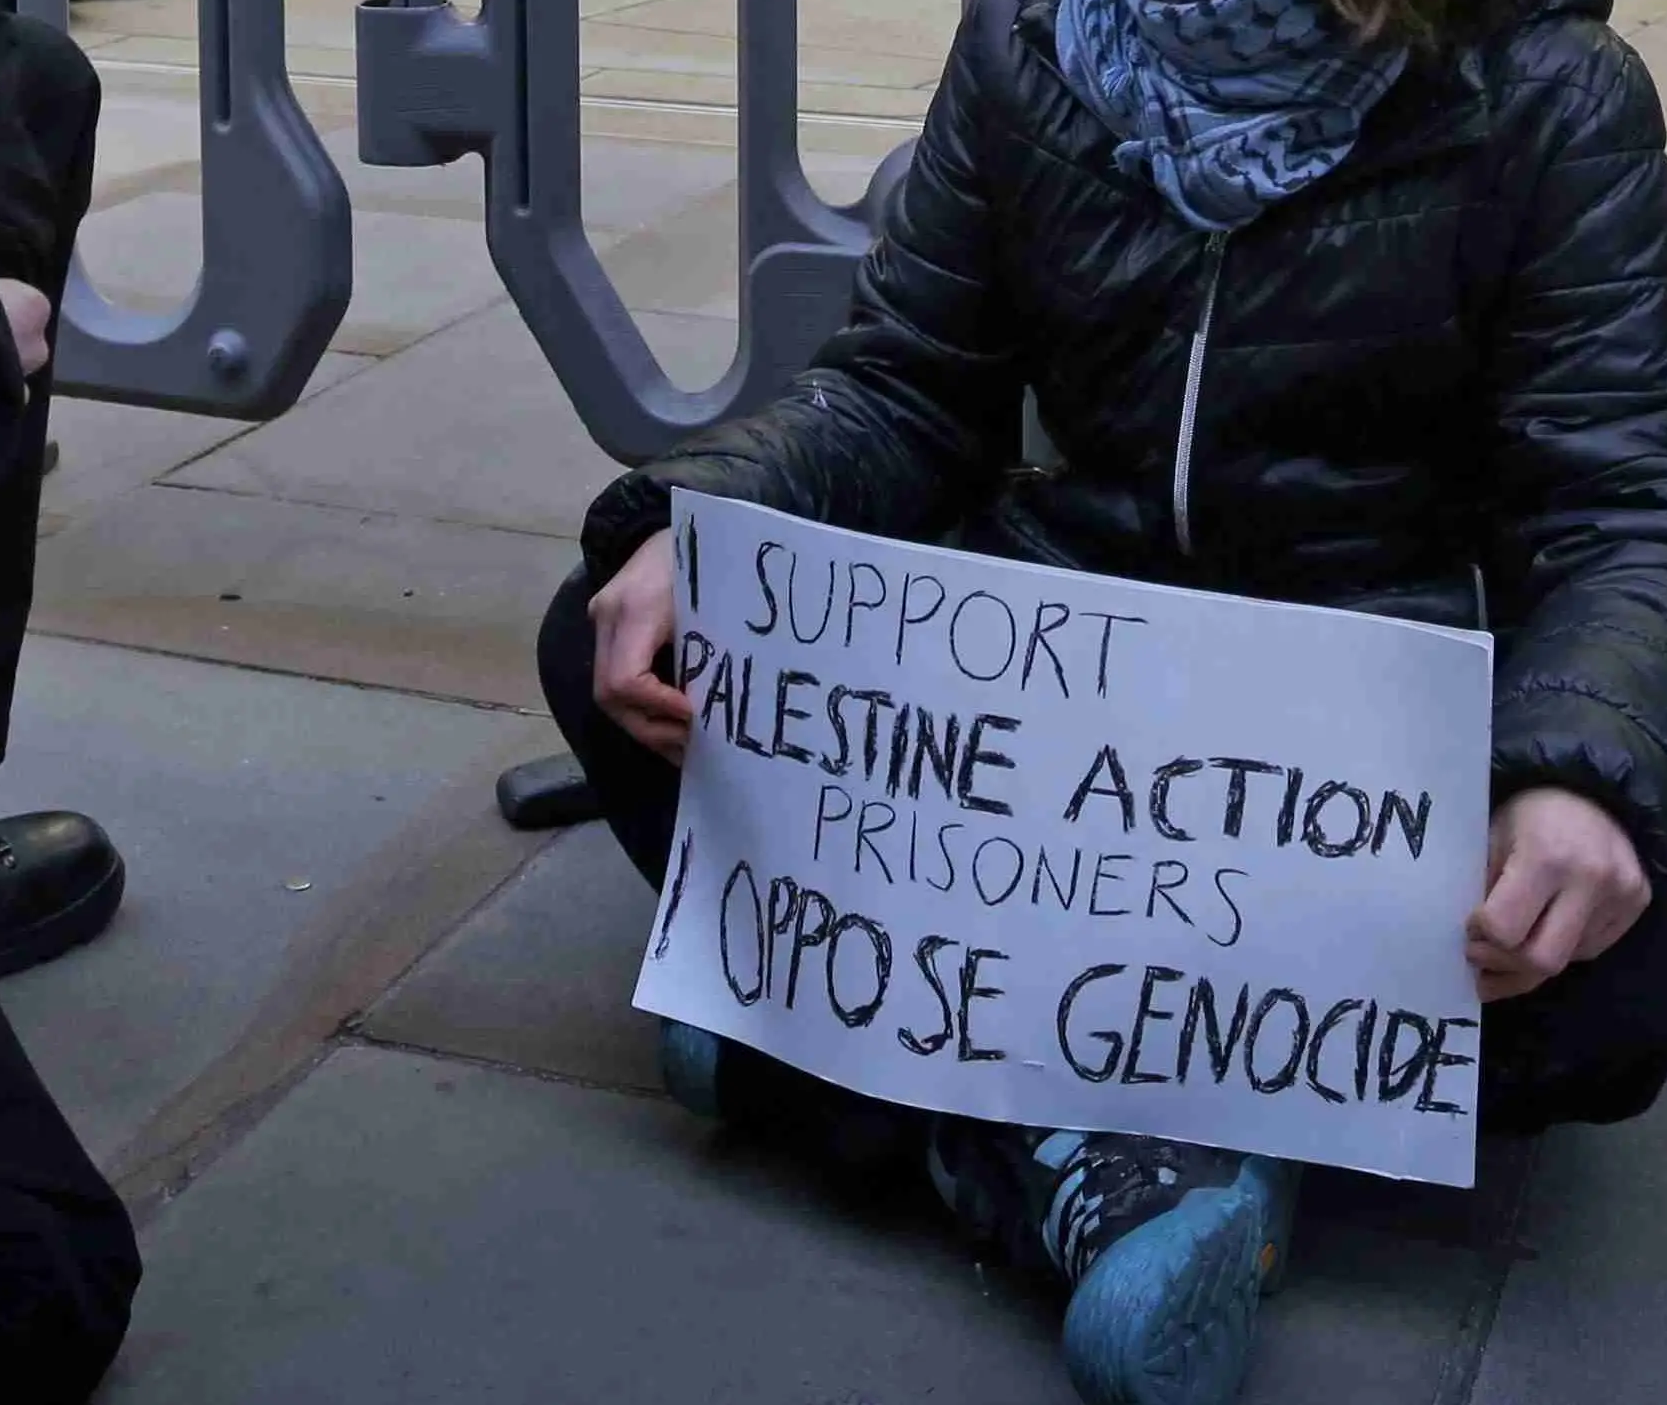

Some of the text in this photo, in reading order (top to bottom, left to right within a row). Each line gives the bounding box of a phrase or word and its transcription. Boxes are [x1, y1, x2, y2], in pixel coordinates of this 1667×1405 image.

[686, 512, 1148, 699] I SUPPORT
[678, 630, 1432, 860] PALESTINE ACTION
[813, 784, 1250, 947] PRISONERS
[653, 826, 1481, 1117] I OPPOSE GENOCIDE
